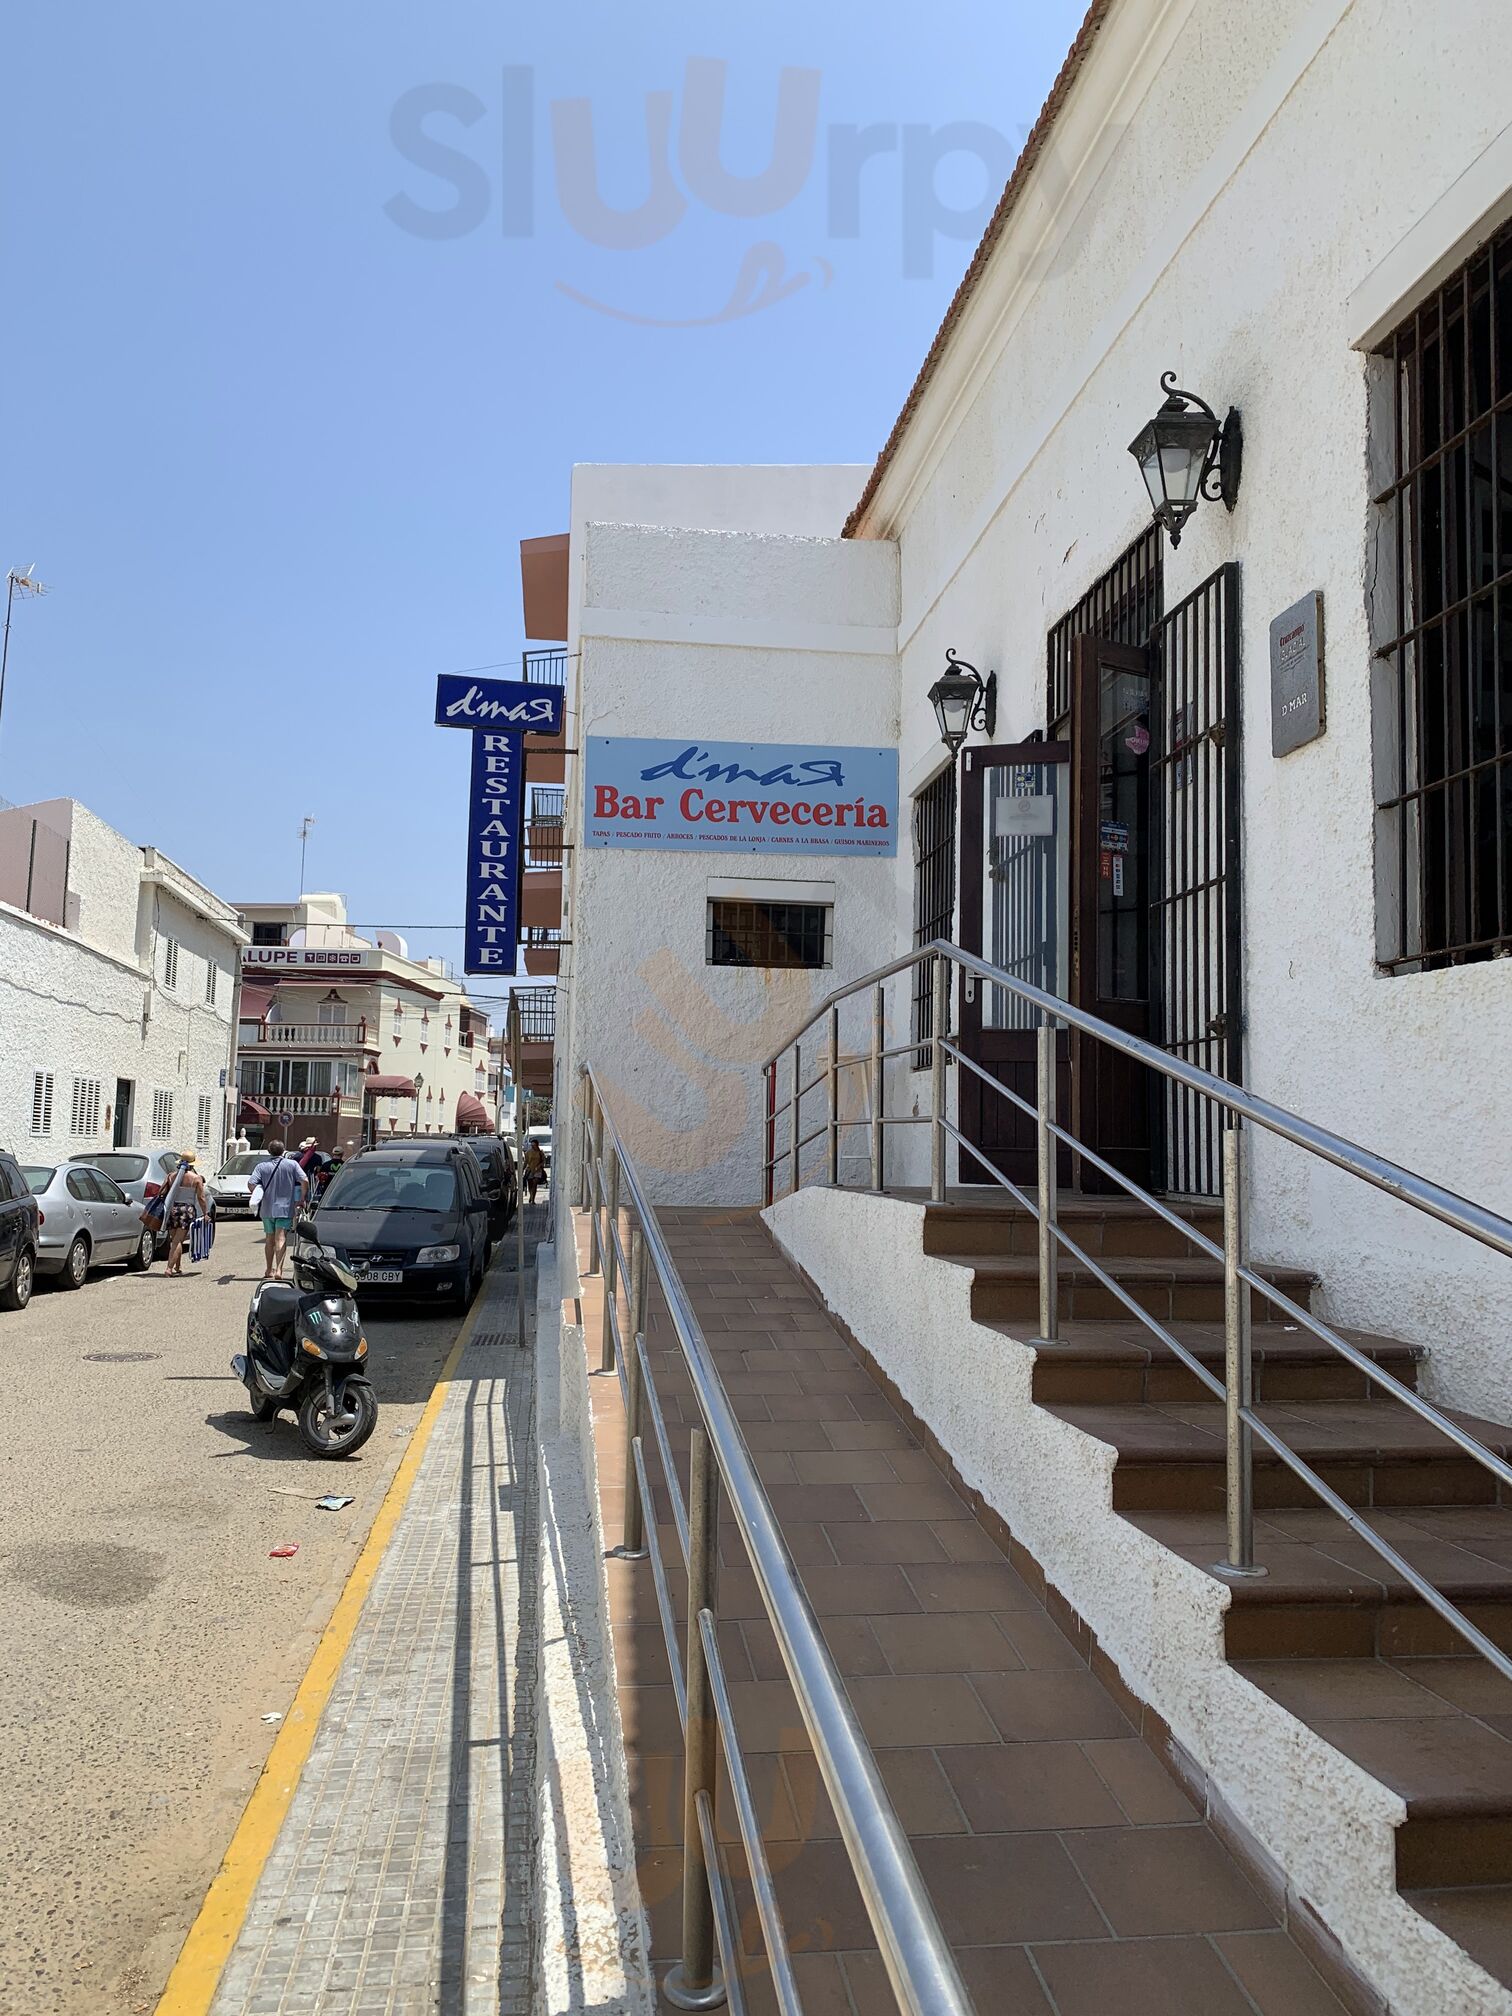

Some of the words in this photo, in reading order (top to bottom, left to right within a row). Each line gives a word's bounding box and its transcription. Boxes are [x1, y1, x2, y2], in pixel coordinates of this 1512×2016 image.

[593, 785, 664, 820] Bar
[680, 788, 890, 828] Cervecería
[616, 831, 643, 839] PESCADO
[476, 734, 512, 966] RESTAURANTE
[243, 951, 298, 963] LUPE
[381, 1271, 401, 1282] CBY
